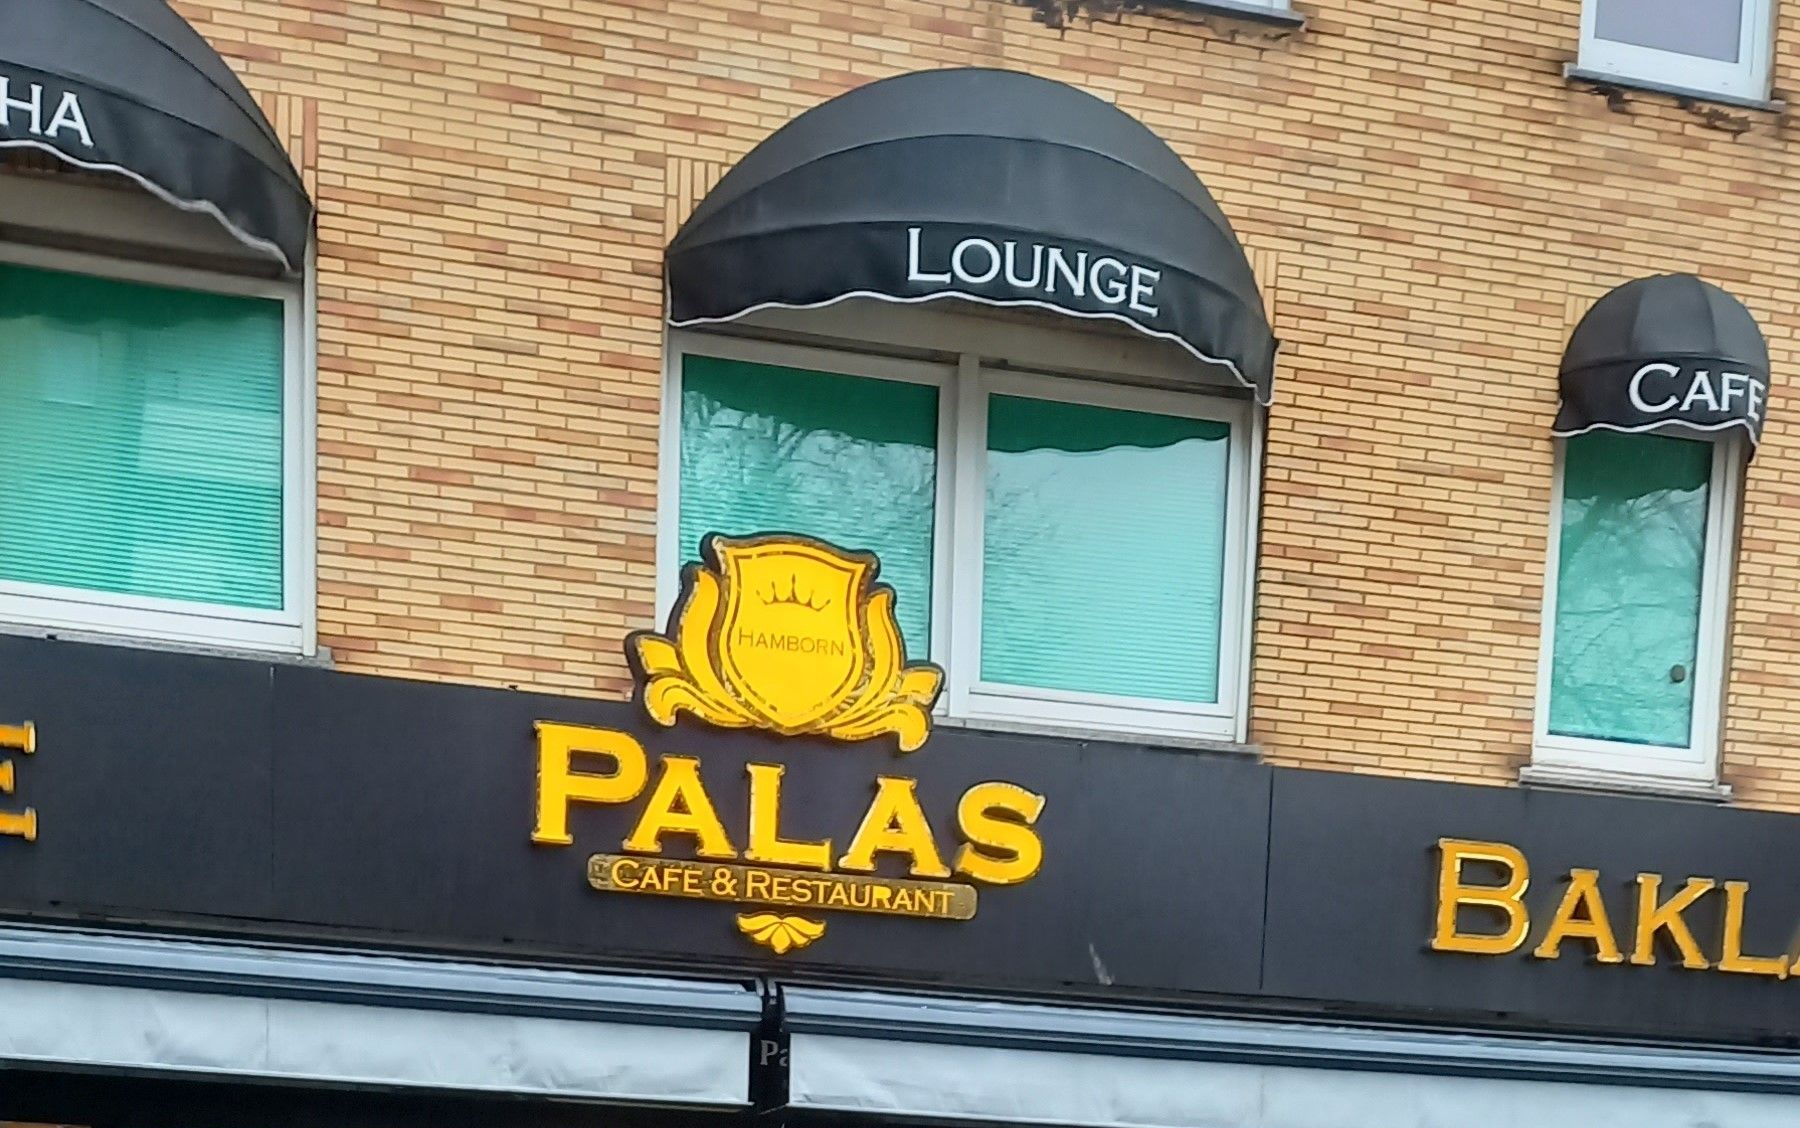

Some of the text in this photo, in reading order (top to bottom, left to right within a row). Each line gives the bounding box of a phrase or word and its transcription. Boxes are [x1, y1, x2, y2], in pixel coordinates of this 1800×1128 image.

[907, 227, 1160, 317] LOUNGE
[1629, 363, 1766, 422] CAFE
[738, 627, 844, 657] HAMBORN
[531, 719, 1047, 884] PALAS
[611, 858, 956, 914] CAFE & RESTAURANT
